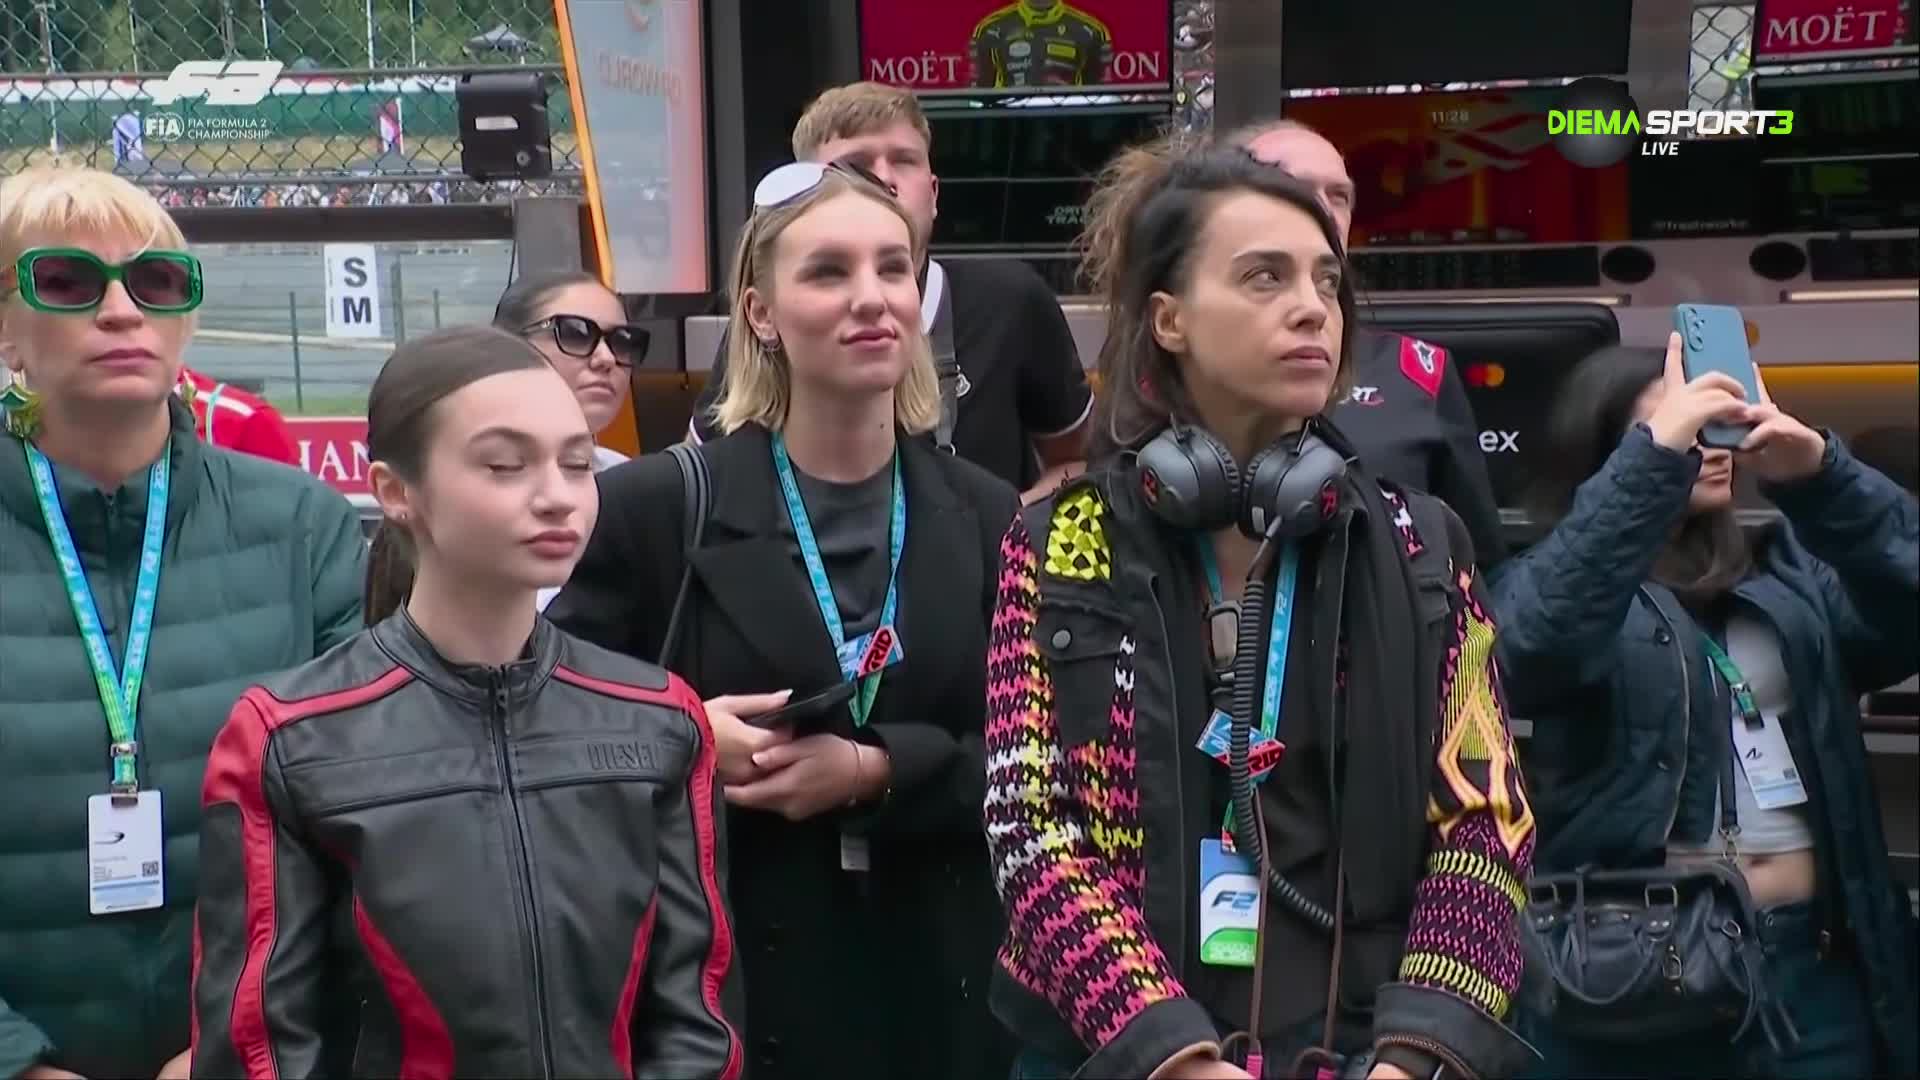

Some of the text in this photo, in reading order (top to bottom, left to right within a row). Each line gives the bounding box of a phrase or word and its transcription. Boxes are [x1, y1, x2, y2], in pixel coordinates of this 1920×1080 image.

[1765, 6, 1887, 48] MOËT
[870, 51, 962, 83] MOËT
[343, 256, 368, 289] S
[342, 296, 372, 324] M
[1478, 429, 1520, 453] ex
[586, 742, 657, 770] DIESEL
[1211, 889, 1259, 909] F2
